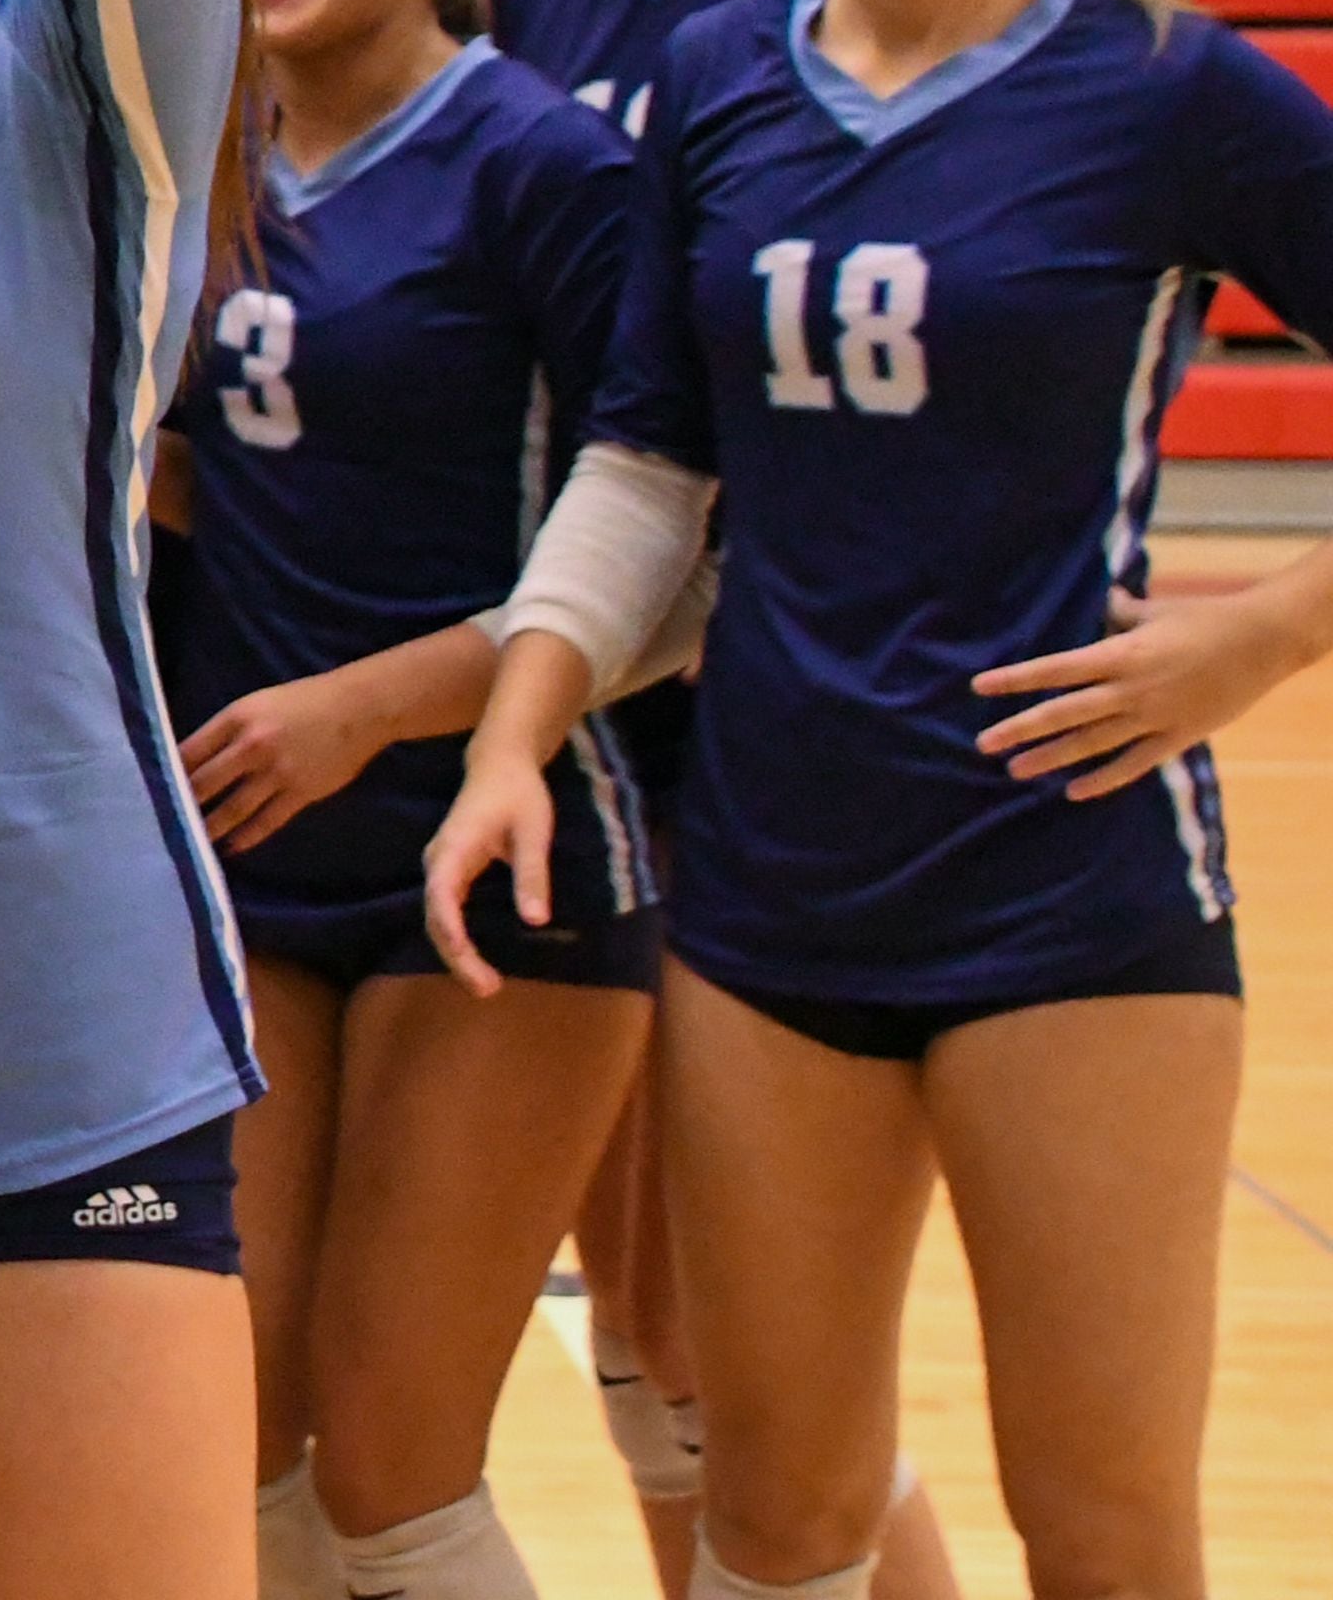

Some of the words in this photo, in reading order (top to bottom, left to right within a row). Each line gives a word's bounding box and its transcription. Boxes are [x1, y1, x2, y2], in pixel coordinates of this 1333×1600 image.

[216, 288, 303, 450] 3
[752, 238, 931, 417] 18
[73, 1200, 178, 1227] adidas
